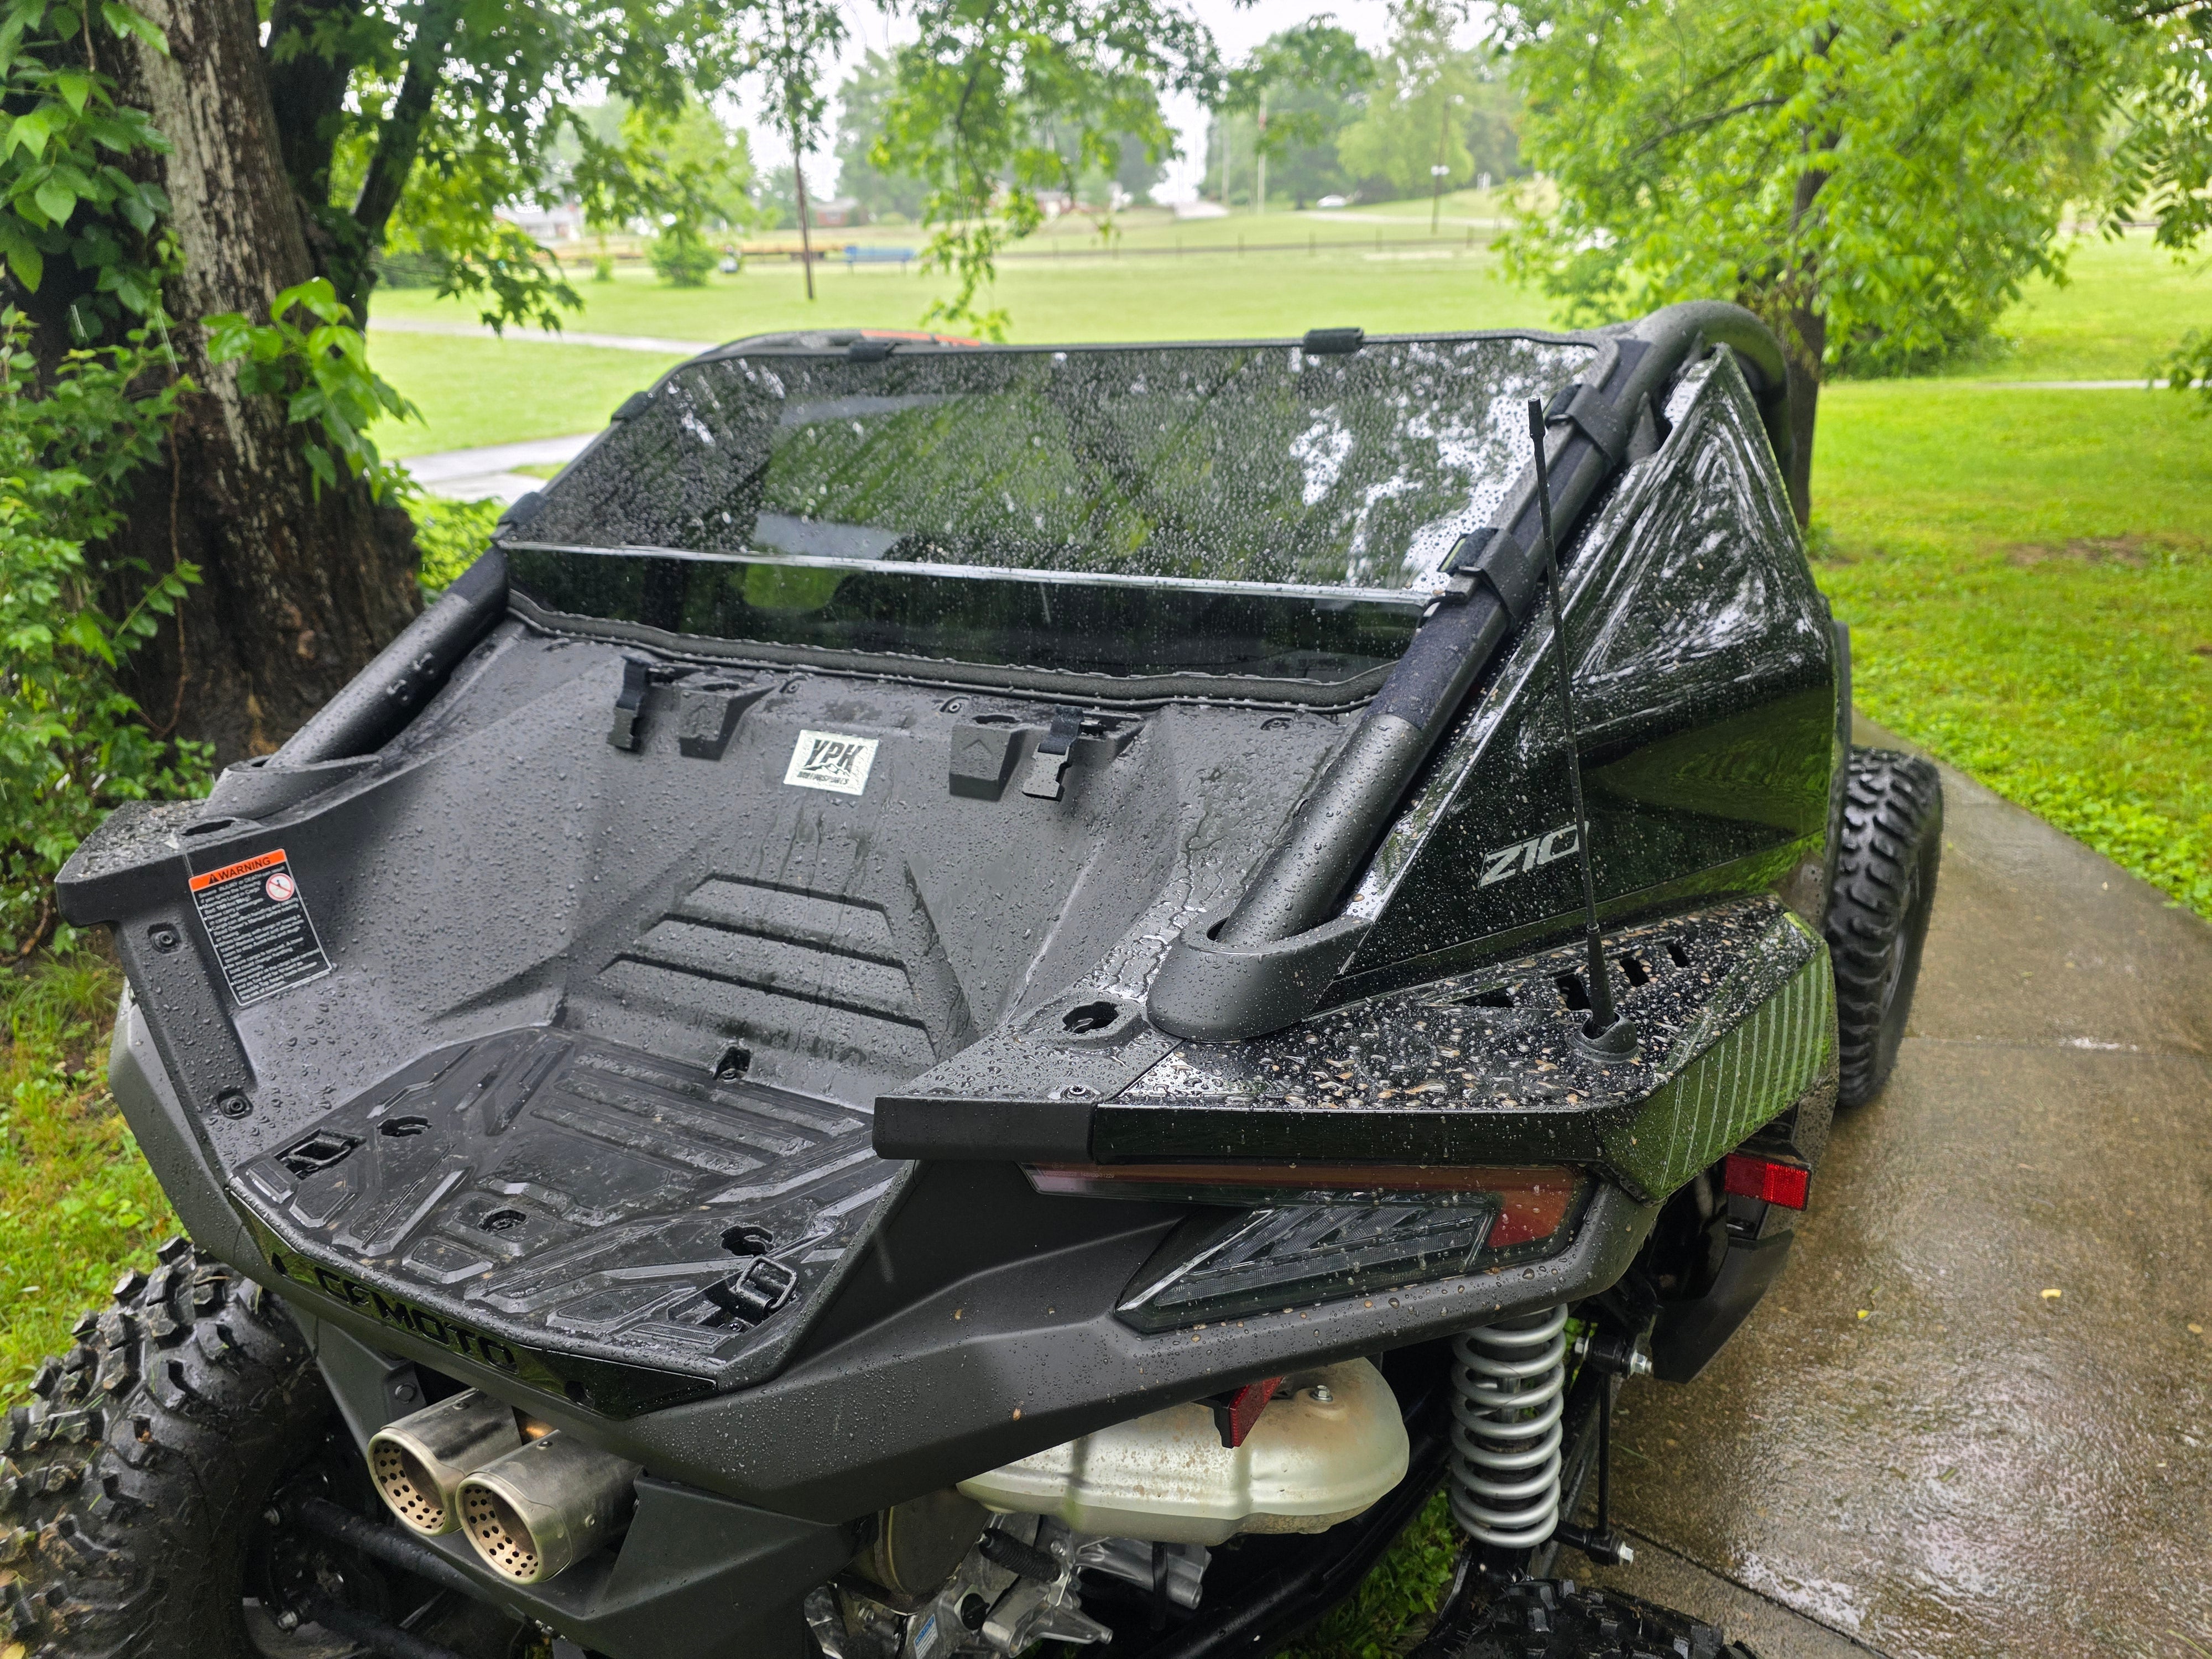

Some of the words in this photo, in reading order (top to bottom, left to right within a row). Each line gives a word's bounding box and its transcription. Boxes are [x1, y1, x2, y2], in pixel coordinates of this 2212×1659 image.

[805, 739, 864, 774] YPK
[217, 857, 271, 881] WARNING
[314, 1267, 520, 1375] CFMOTO
